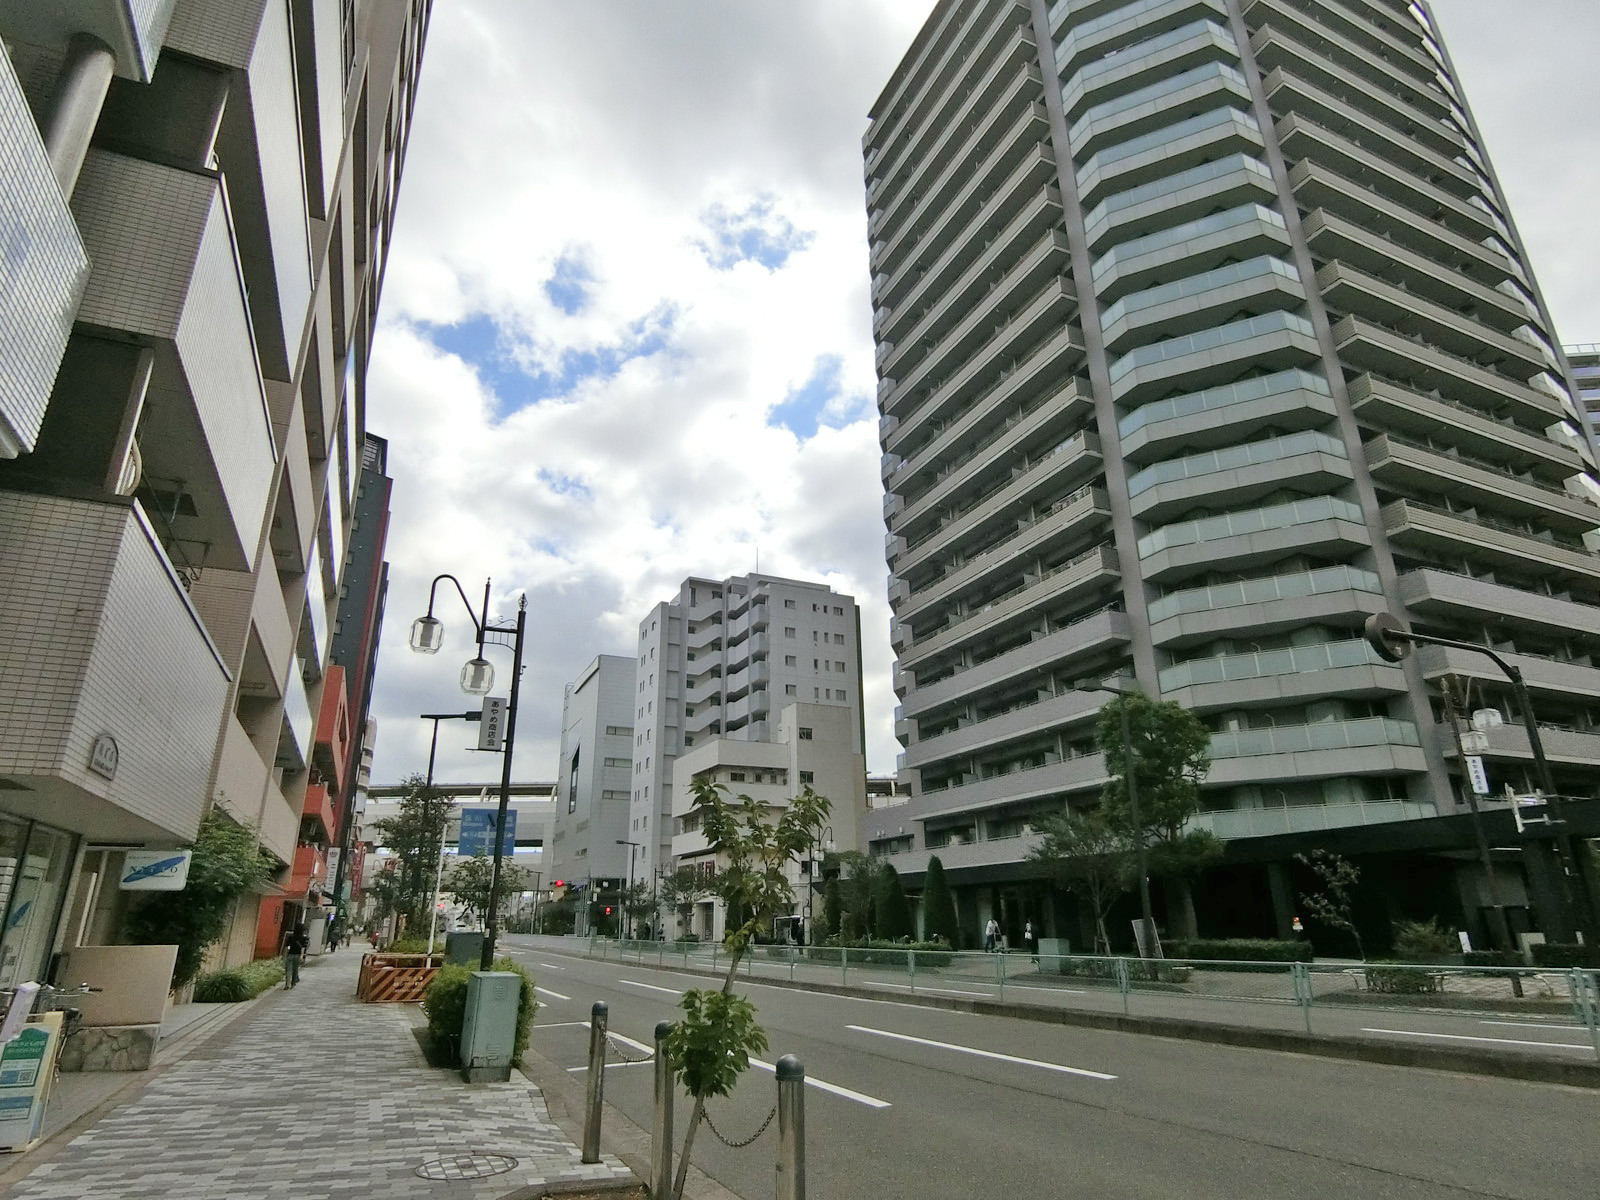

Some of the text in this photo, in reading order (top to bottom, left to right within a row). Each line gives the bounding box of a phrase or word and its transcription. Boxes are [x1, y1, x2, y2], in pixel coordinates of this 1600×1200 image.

[487, 700, 500, 747] あやめ商店会
